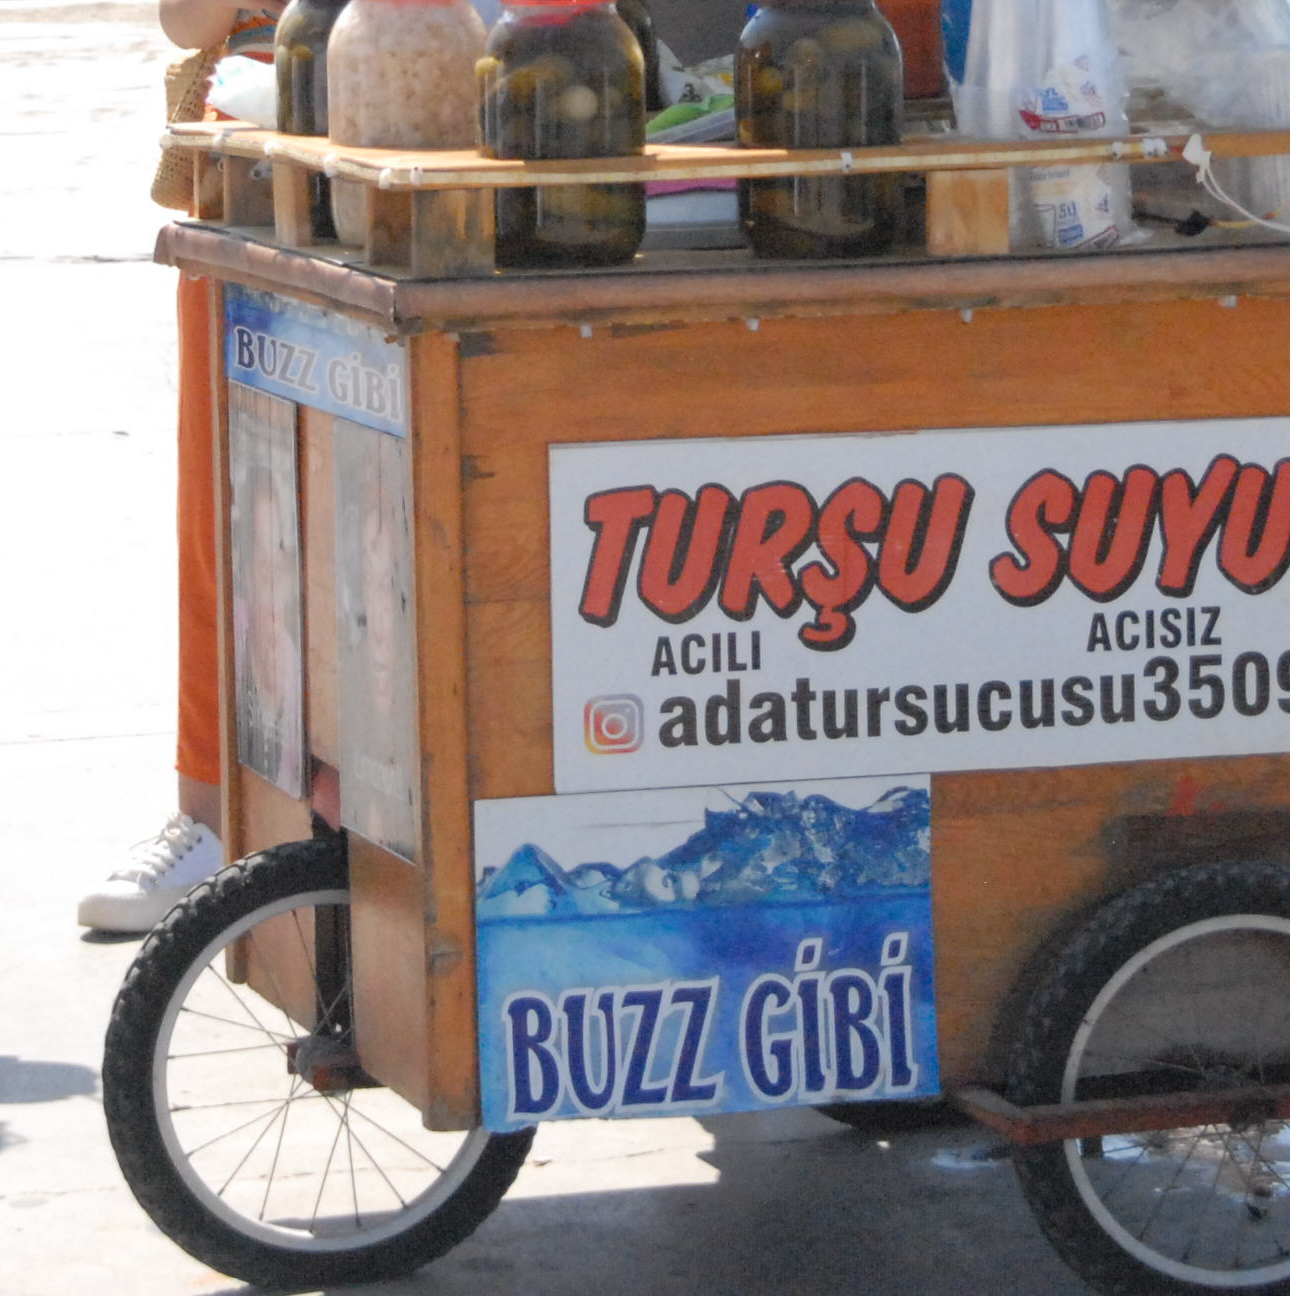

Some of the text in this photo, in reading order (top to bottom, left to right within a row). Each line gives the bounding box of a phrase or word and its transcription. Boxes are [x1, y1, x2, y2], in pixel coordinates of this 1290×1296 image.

[234, 326, 403, 422] BUZZ GİBİ
[579, 472, 975, 652] TURŞU
[651, 630, 761, 677] ACILI
[1086, 606, 1222, 652] ACISIZ
[504, 932, 917, 1117] BUZZ GİBİ
